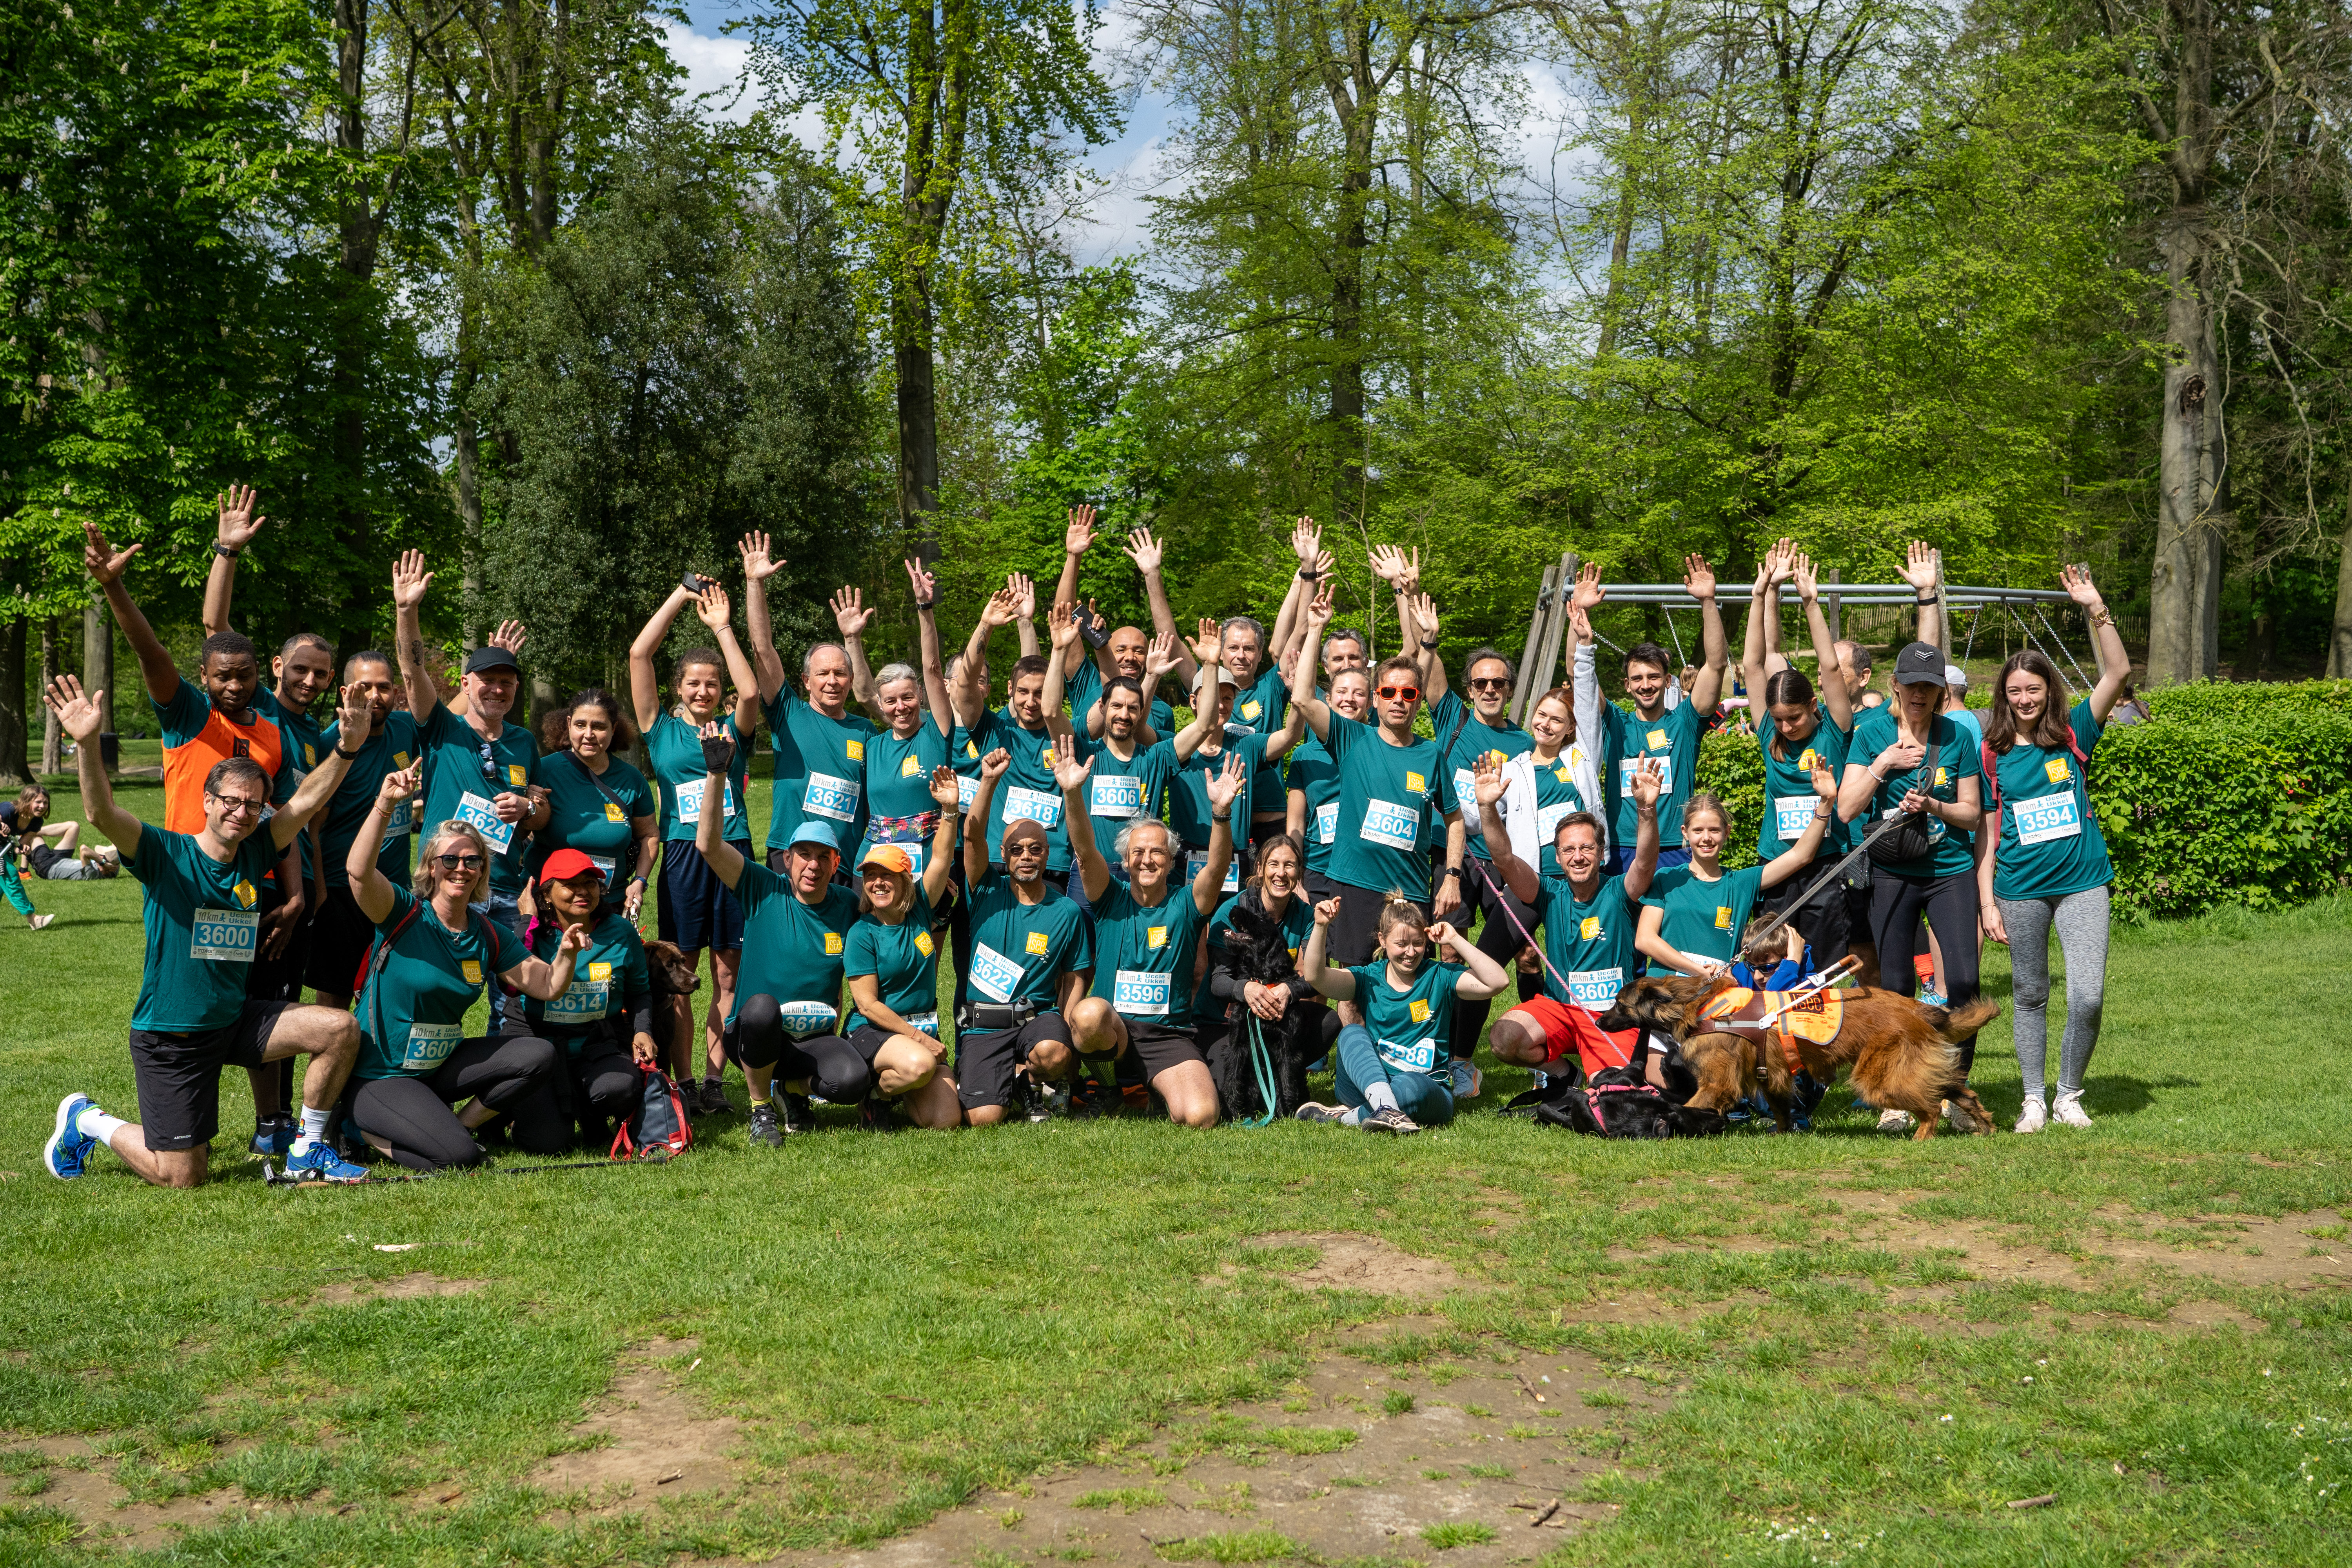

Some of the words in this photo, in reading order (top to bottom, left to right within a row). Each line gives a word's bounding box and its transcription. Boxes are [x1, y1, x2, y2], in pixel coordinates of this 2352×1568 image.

[1243, 705, 1259, 717] Isee
[1649, 734, 1666, 747] Isee
[849, 743, 862, 759] Isee
[511, 768, 525, 784] Isee
[2047, 764, 2068, 780] Isee
[1409, 774, 1423, 790] Isee
[812, 788, 852, 811] 3621
[1097, 788, 1136, 805] 3606
[1457, 783, 1476, 800] 36
[2045, 793, 2067, 802] Uccle
[1011, 799, 1053, 821] 3618
[1399, 807, 1416, 815] Uccle
[2047, 799, 2068, 807] Ukkel
[461, 808, 507, 840] 3624
[1398, 812, 1415, 820] Ukkel
[1781, 811, 1813, 829] 358
[2023, 806, 2073, 831] 3594
[1370, 813, 1413, 838] 3604
[1718, 910, 1730, 926] Isee
[199, 925, 249, 946] 3600
[1150, 931, 1166, 945] Isee
[1582, 923, 1599, 937] Isee
[827, 936, 841, 951] Isee
[1029, 935, 1045, 952] Isee
[464, 964, 480, 980] Isee
[999, 963, 1017, 975] Ukkel
[1001, 958, 1019, 970] Uccle
[592, 966, 610, 980] Isee
[975, 958, 1012, 991] 3622
[1120, 984, 1163, 1002] 3596
[1575, 982, 1617, 1000] 3602
[552, 994, 601, 1011] 3614
[1793, 993, 1821, 1011] Isee
[1412, 1006, 1428, 1020] Isee
[785, 1016, 828, 1031] 3611
[414, 1040, 457, 1058] 3601
[1385, 1042, 1427, 1065] 3588
